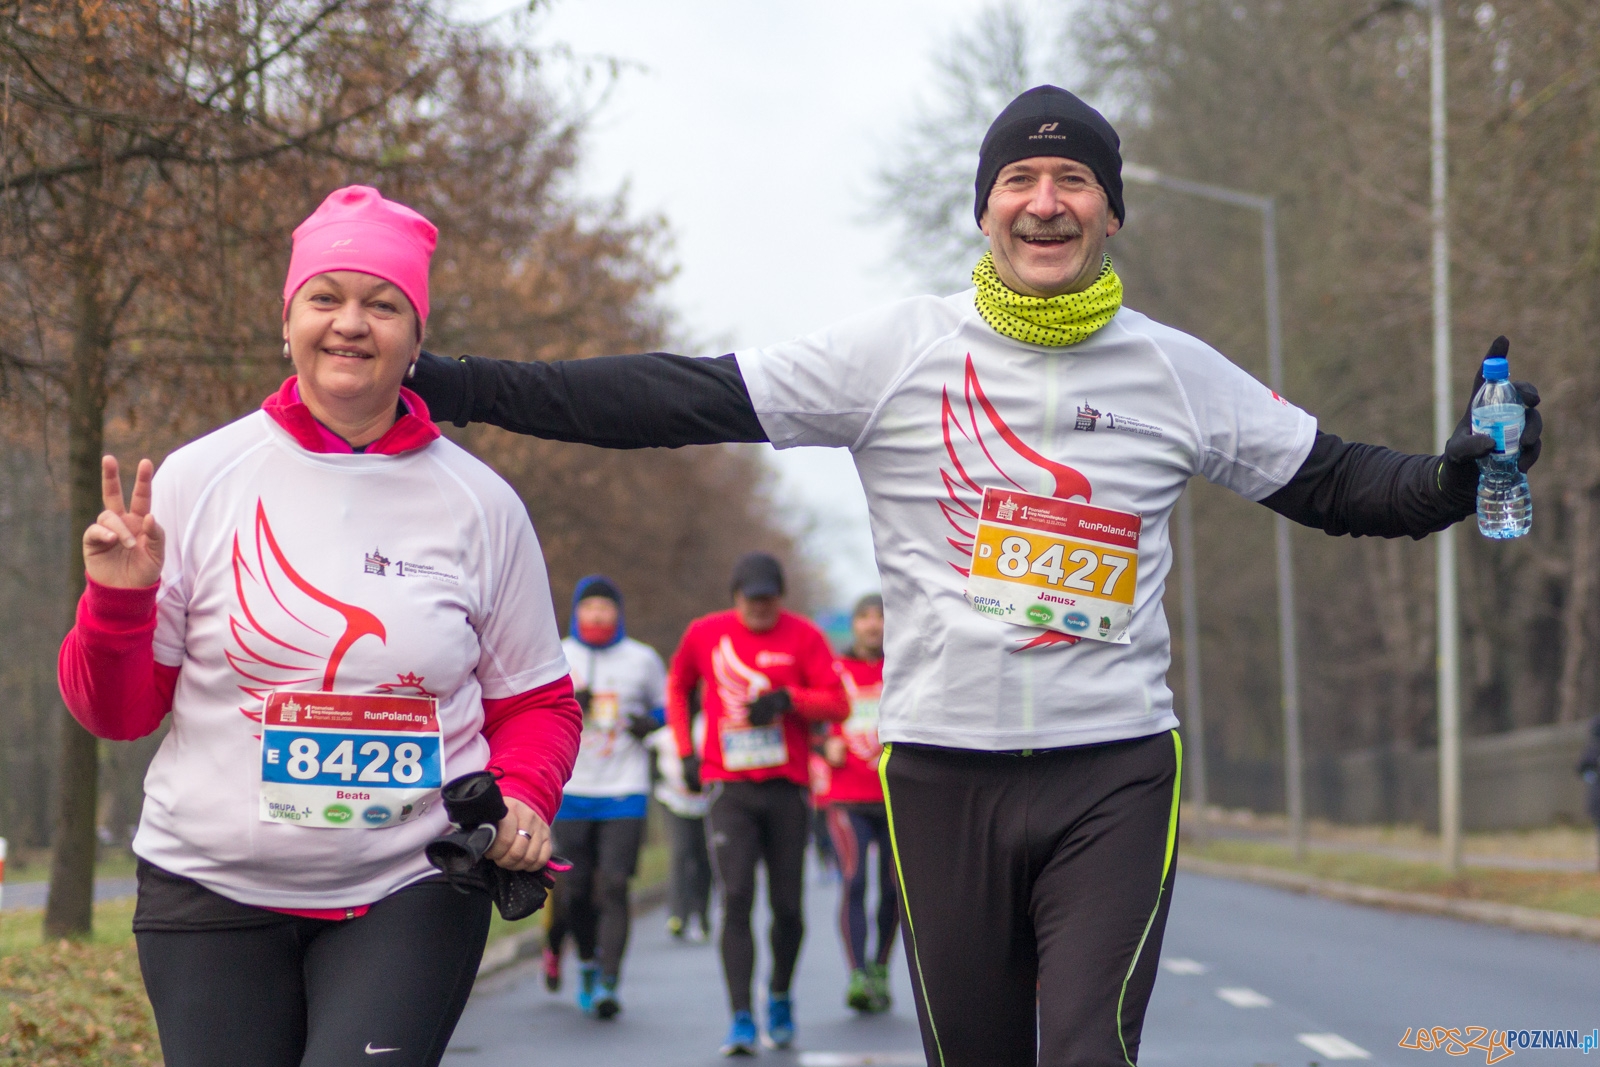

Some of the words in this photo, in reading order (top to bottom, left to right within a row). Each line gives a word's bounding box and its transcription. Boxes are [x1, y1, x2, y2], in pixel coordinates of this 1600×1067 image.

[1105, 412, 1116, 430] 1
[1020, 506, 1029, 520] 1
[1078, 519, 1137, 541] RunPoland.org
[395, 560, 406, 577] 1
[979, 543, 992, 558] D
[996, 536, 1130, 596] 8427
[974, 595, 1000, 608] GRUPA
[1037, 592, 1077, 607] Janusz
[304, 704, 313, 720] 1
[363, 711, 428, 725] RunPoland.org
[267, 749, 280, 764] E
[286, 737, 423, 784] 8428
[336, 790, 371, 801] Beata
[269, 802, 297, 812] GRUPA
[268, 810, 302, 821] LUXMED
